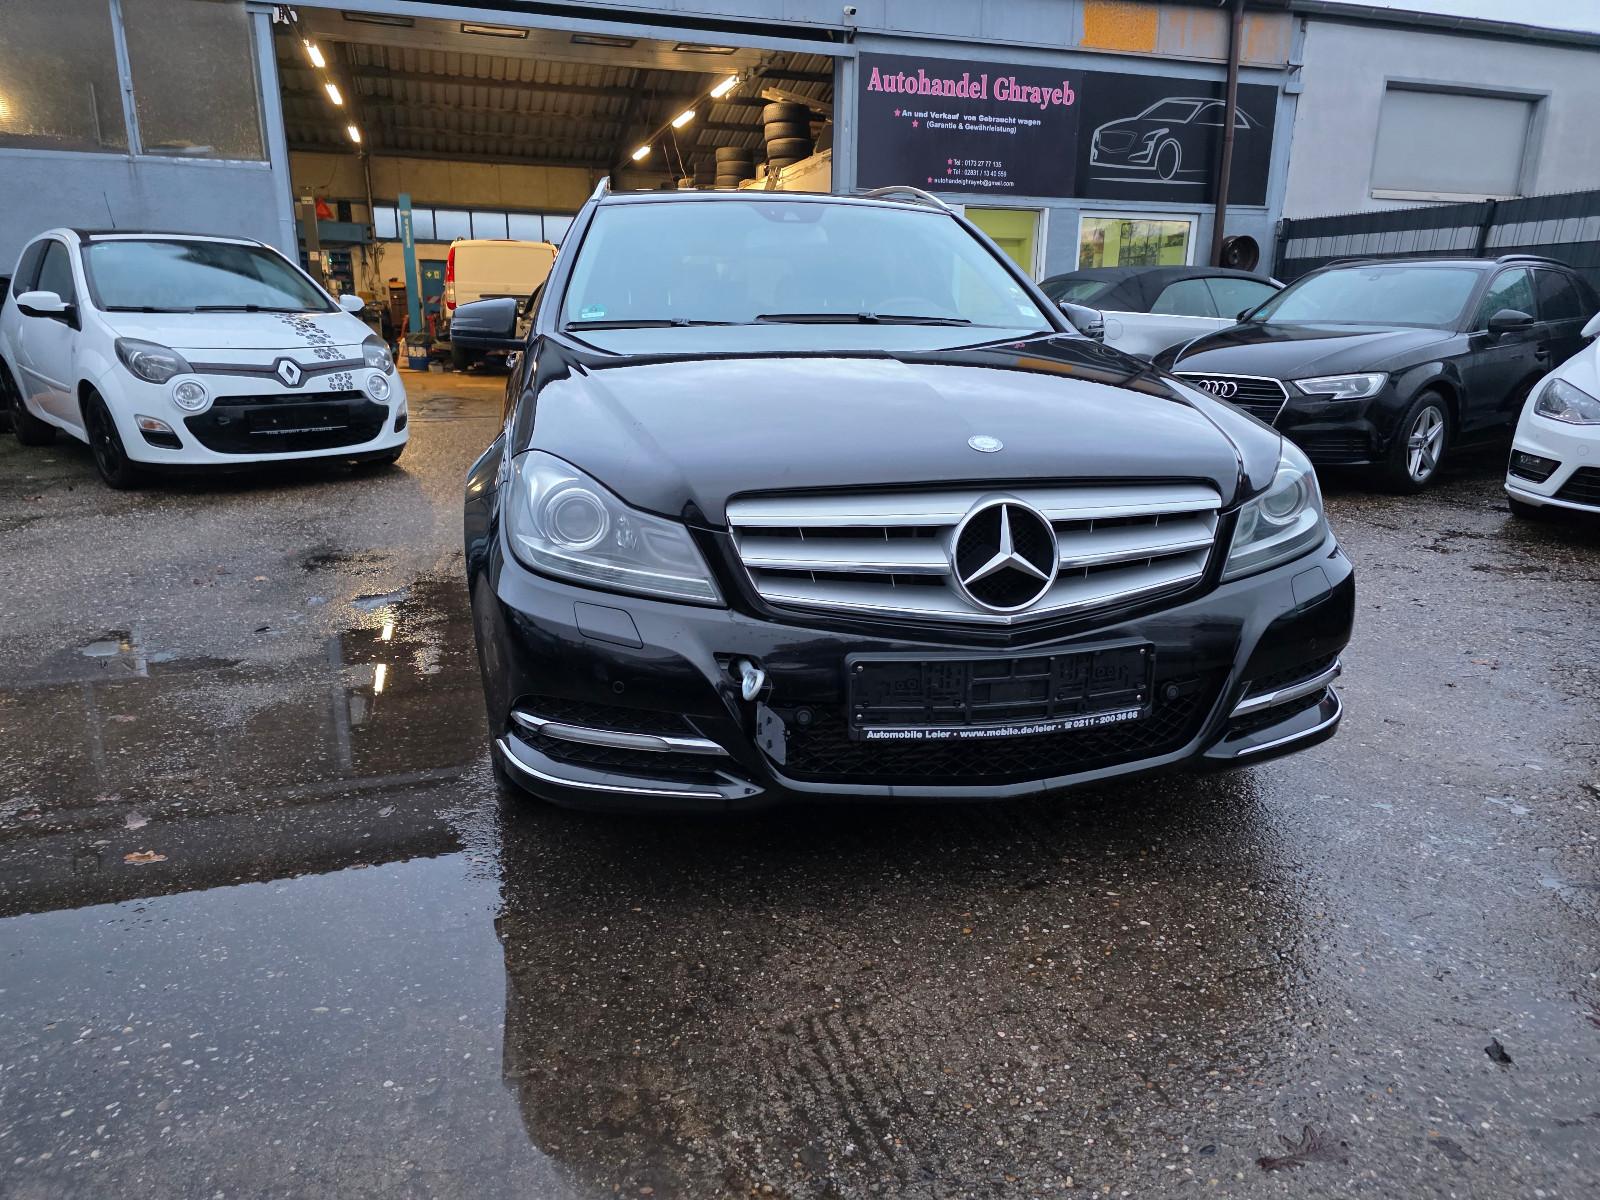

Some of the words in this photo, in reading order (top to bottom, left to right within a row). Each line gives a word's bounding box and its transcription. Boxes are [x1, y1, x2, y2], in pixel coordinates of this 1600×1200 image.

[867, 66, 988, 99] Autohandel
[993, 76, 1075, 110] Ghrayeb
[926, 121, 957, 129] (Garantie
[930, 112, 959, 120] Verkauf
[978, 115, 1016, 124] Gebraucht
[1017, 118, 1041, 126] wagen
[866, 730, 923, 739] Automobile
[925, 730, 951, 739] Leier
[959, 725, 1056, 738] www.mobile.de/leier
[1073, 718, 1095, 728] 0211
[1099, 714, 1116, 724] 200
